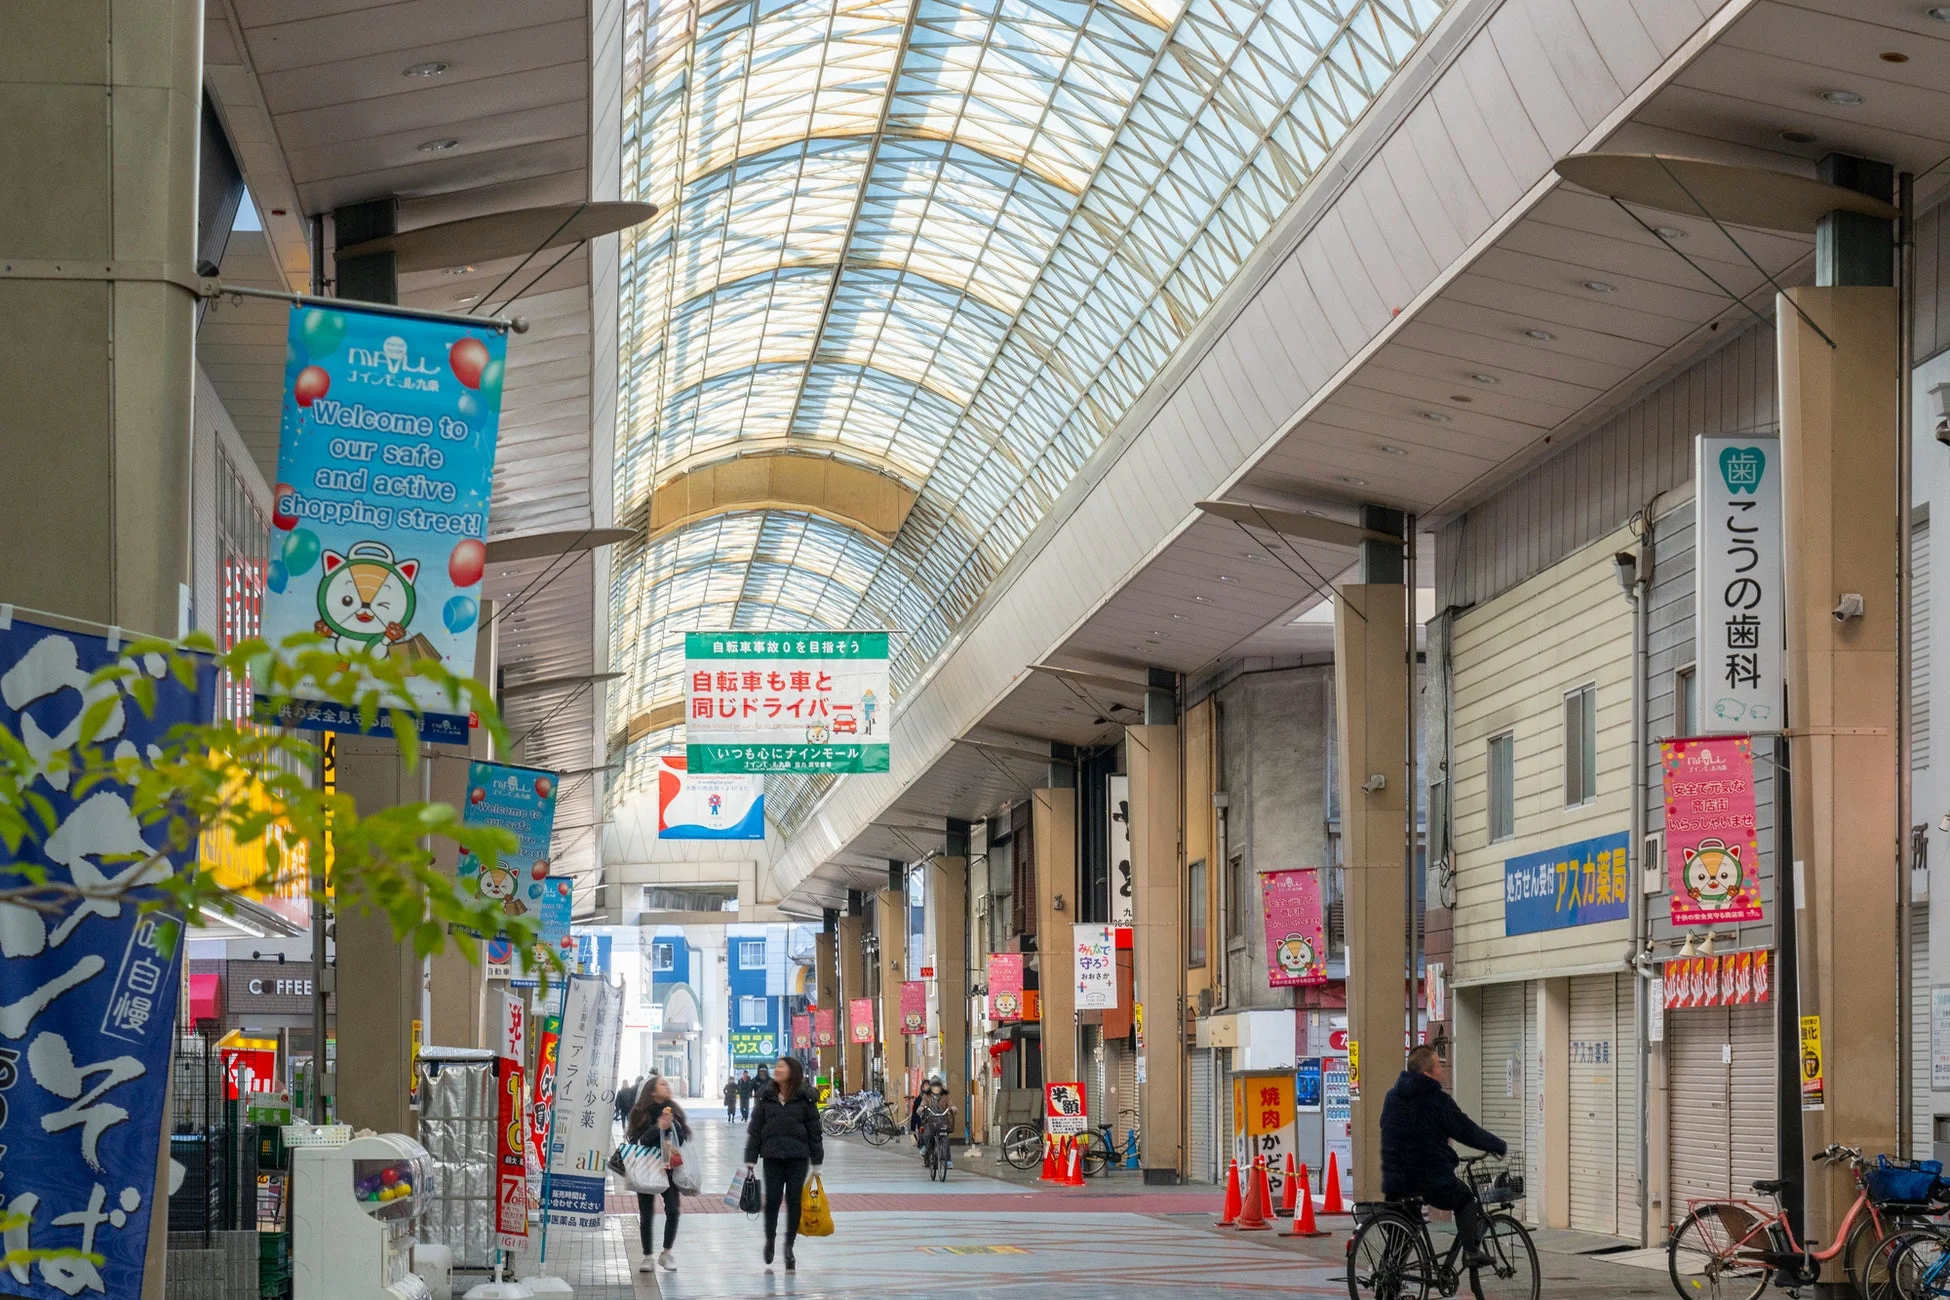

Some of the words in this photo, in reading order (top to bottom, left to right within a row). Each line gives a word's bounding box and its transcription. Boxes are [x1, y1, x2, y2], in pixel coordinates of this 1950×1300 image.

[312, 398, 433, 437] Welcome
[439, 415, 469, 441] to
[329, 438, 378, 461] our
[383, 443, 444, 470] safe
[1727, 454, 1758, 485] 歯
[315, 468, 368, 493] and
[373, 474, 457, 503] active
[279, 493, 392, 530] shopping
[397, 507, 482, 537] street!
[1724, 500, 1762, 689] こうの歯科
[713, 640, 860, 654] 自転車事故0を目指そう
[692, 671, 833, 693] 自転車も車と
[692, 697, 853, 719] 同じドライバー
[717, 747, 859, 761] いつも心にナインモール
[1672, 779, 1746, 796] 安全で元気な
[477, 801, 528, 818] Welcome
[530, 809, 542, 820] to
[1691, 799, 1729, 813] 商店街
[506, 820, 532, 832] safe
[1668, 814, 1754, 832] いらっしゃいませ
[1506, 861, 1555, 903] 処方せん受付
[1555, 847, 1627, 913] アスカ薬局
[1078, 943, 1111, 956] みんなで
[1079, 956, 1109, 970] 守ろう
[249, 979, 313, 995] COFFEE
[1081, 972, 1111, 980] おおさか
[1573, 1042, 1609, 1064] アスカ薬局
[1052, 1086, 1080, 1115] 半額
[1260, 1087, 1280, 1129] 焼肉
[1262, 1133, 1283, 1194] かどや
